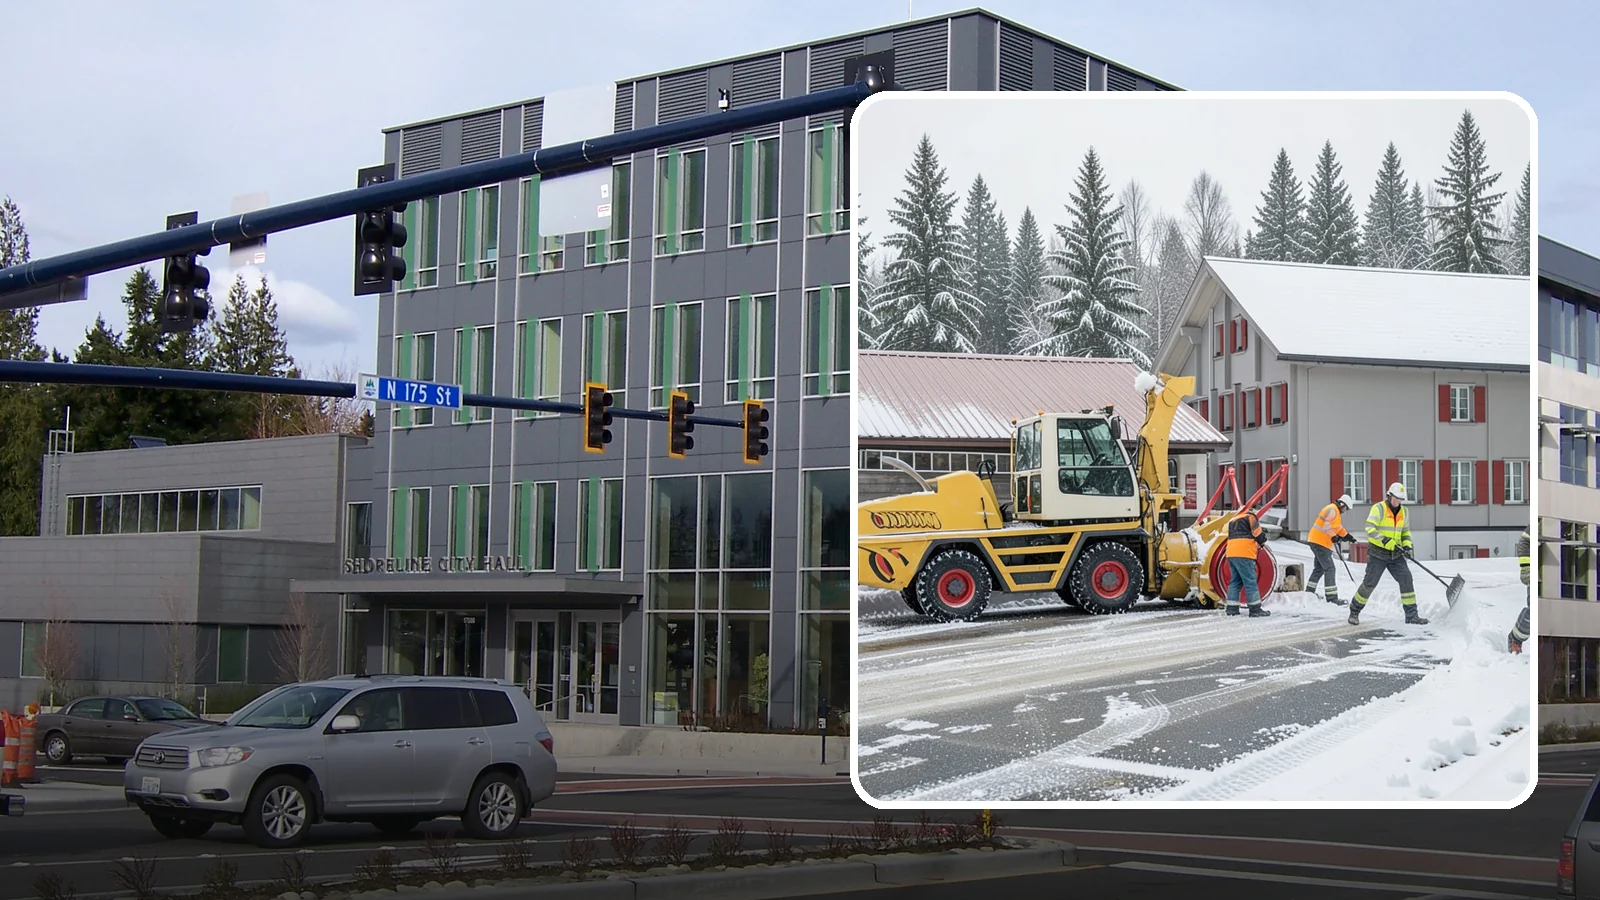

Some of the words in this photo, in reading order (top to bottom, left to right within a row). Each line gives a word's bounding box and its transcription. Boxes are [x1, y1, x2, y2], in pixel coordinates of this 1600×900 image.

[387, 380, 396, 400] N
[404, 382, 428, 403] 175
[435, 386, 452, 406] St
[344, 556, 433, 574] SHORELINE
[438, 556, 476, 573] CITY
[483, 555, 526, 572] HALL
